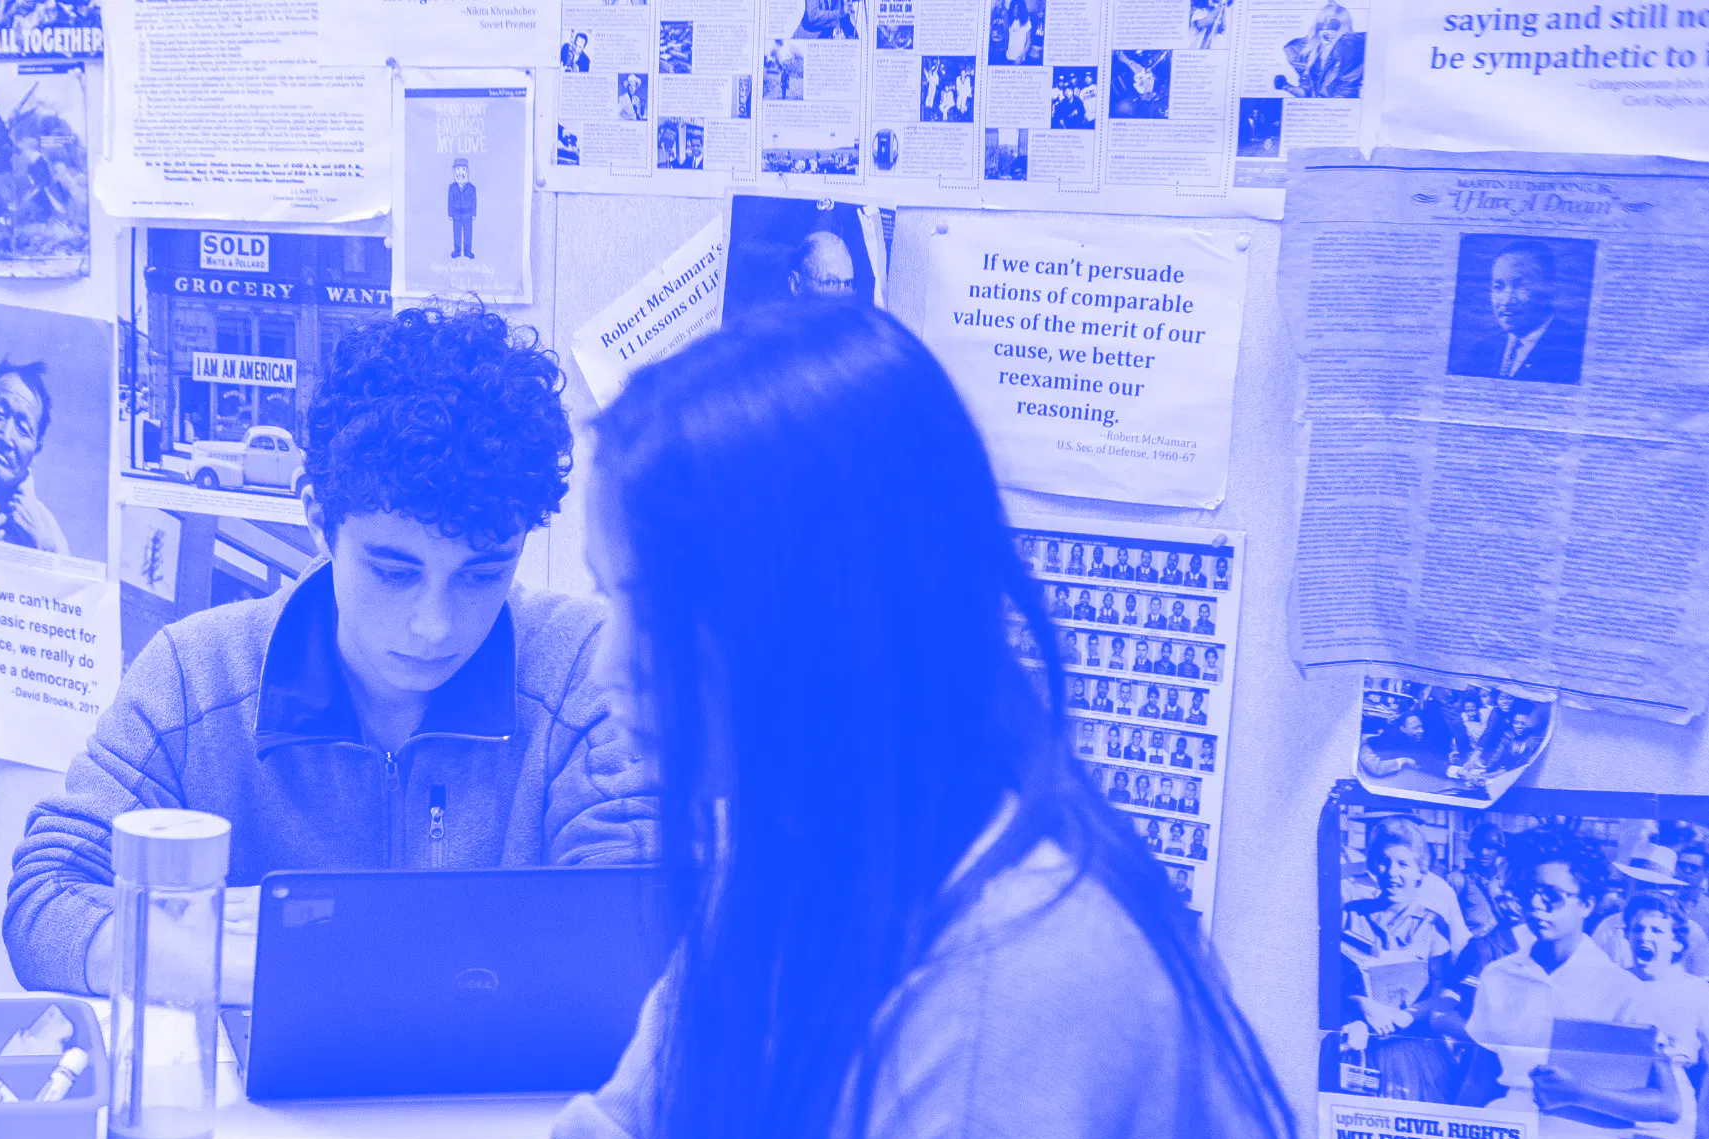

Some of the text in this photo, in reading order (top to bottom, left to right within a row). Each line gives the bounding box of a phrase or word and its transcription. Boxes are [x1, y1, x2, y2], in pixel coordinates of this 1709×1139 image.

[490, 6, 537, 16] Khrushchev
[880, 3, 912, 13] GO BACK ON
[1444, 8, 1538, 37] saying
[1546, 5, 1602, 30] and
[1609, 3, 1669, 30] still
[479, 20, 504, 29] Soviet
[23, 27, 104, 54] TOGETHER
[1430, 46, 1465, 69] be
[1473, 45, 1657, 75] sympathetic
[1666, 45, 1698, 68] to
[436, 118, 485, 135] EMBARGO
[437, 136, 487, 153] MY LOVE
[203, 235, 266, 257] SOLD
[235, 258, 266, 269] POLLARD
[982, 253, 1185, 284] If we can't persuade
[175, 276, 295, 299] GROCERY
[600, 243, 723, 349] Robert McNamara's
[968, 284, 1194, 314] nations of comparable
[618, 269, 721, 362] 11 Lessons of Lif
[953, 309, 1206, 344] values of the merit of our
[668, 331, 686, 349] with
[994, 341, 1155, 370] cause, we better
[197, 356, 294, 383] I AM AN AMERICAN
[999, 369, 1145, 397] reexamine our
[1016, 398, 1119, 428] reasoning.
[1056, 440, 1196, 463] U.S. Sec. of Defense, 1960-67
[1142, 434, 1197, 449] McNamara
[19, 592, 51, 610] can't
[53, 598, 82, 617] have
[29, 619, 76, 641] respect
[80, 628, 97, 644] for
[19, 644, 37, 657] we
[40, 647, 75, 667] really
[78, 652, 95, 669] do
[10, 665, 17, 677] a
[21, 667, 98, 696] democracy."
[11, 686, 100, 715] -David Brooks, 2017
[1336, 1113, 1391, 1128] upfront
[1394, 1117, 1444, 1137] CIVIL
